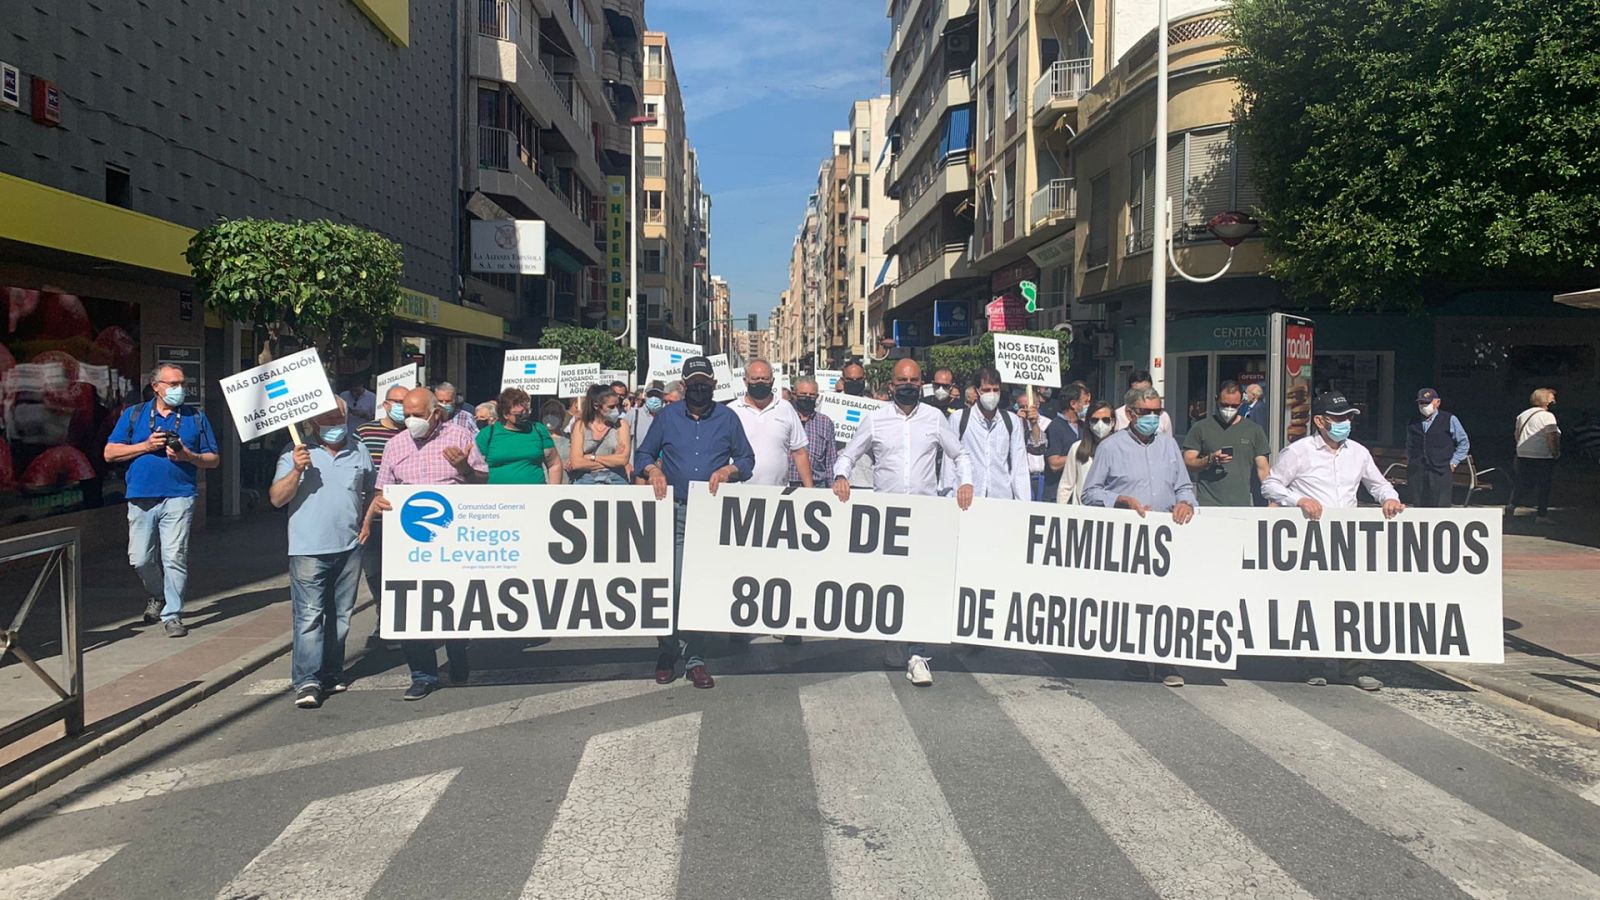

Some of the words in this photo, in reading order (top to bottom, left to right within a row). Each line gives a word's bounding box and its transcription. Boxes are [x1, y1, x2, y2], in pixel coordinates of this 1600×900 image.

[610, 203, 622, 311] HIPERBER
[1213, 326, 1267, 338] CENTRAL
[520, 353, 559, 361] DESALACIÓN
[651, 341, 664, 350] MÁS
[664, 345, 702, 355] DESALACIÓN
[998, 341, 1021, 352] NOS
[1024, 342, 1056, 355] ESTÁIS
[997, 352, 1058, 365] AHOGANDO...
[1004, 361, 1011, 369] Y
[1013, 361, 1028, 370] NO
[1030, 362, 1053, 373] CON
[226, 379, 250, 395] MÁS
[250, 355, 317, 386] DESALACIÓN
[561, 369, 576, 377] NOS
[576, 367, 598, 376] ESTÁIS
[1014, 370, 1045, 381] AGUA
[243, 408, 267, 424] MÁS
[268, 388, 323, 415] CONSUMO
[824, 394, 840, 404] MÁS
[254, 401, 319, 431] ENERGÉTICO
[457, 503, 497, 511] Comunidad
[498, 503, 525, 511] General
[468, 513, 500, 521] Regantes
[719, 486, 832, 553] MÁS
[848, 503, 912, 557] DE
[456, 526, 521, 546] Riegos
[547, 498, 656, 565] SIN
[408, 546, 433, 562] de
[440, 546, 521, 562] Levante
[1026, 514, 1173, 578] FAMILIAS
[385, 576, 669, 632] TRASVASE
[730, 575, 905, 635] 80.000
[956, 586, 996, 640] DE
[1003, 591, 1234, 664] AGRICULTORES
[1268, 599, 1320, 651] LA
[1334, 600, 1470, 656] RUINA
